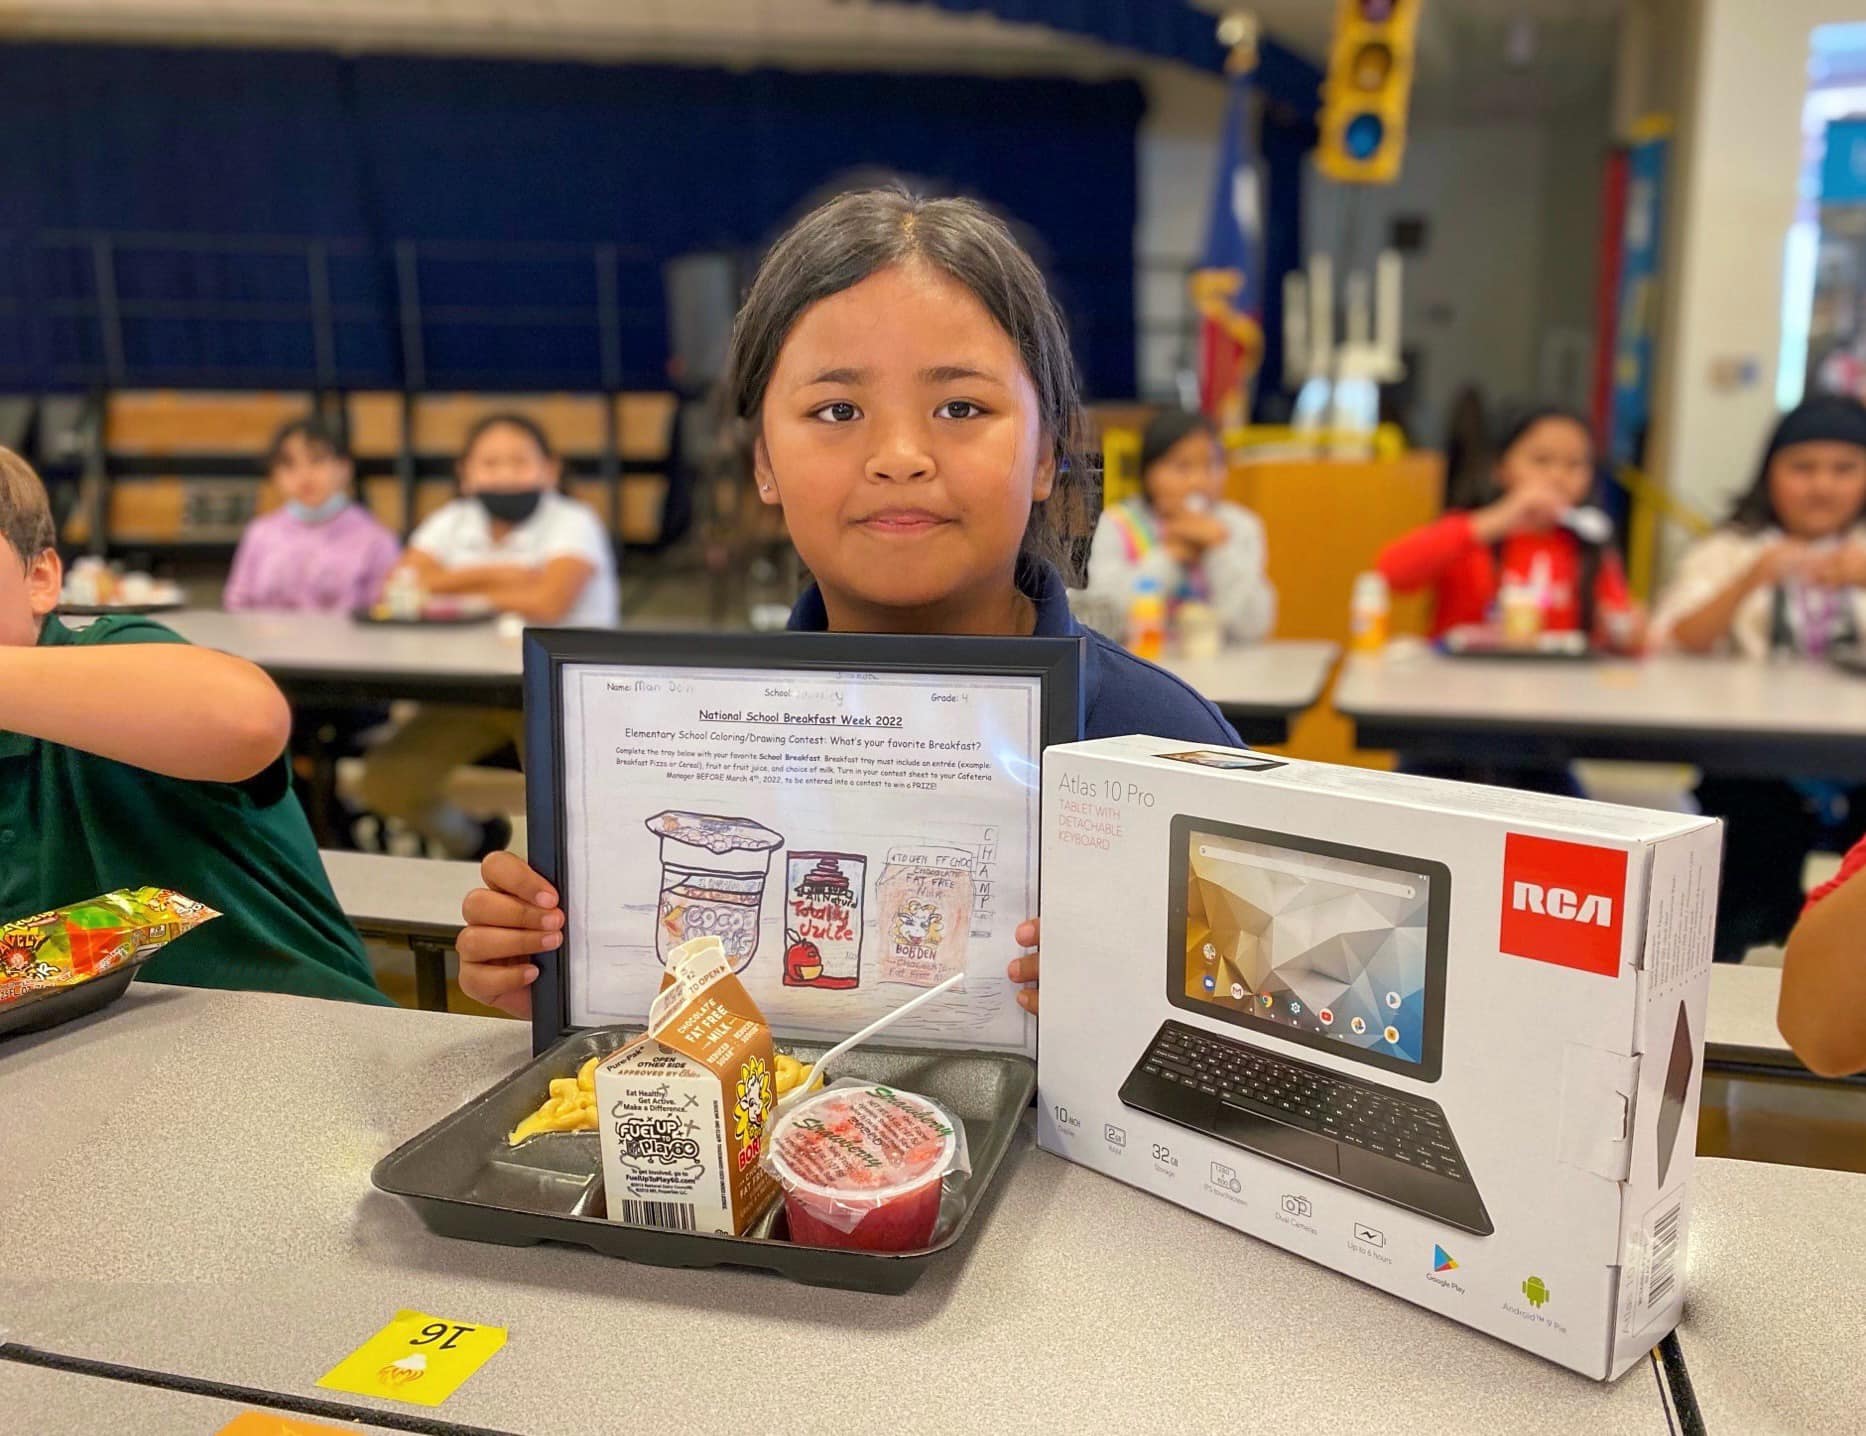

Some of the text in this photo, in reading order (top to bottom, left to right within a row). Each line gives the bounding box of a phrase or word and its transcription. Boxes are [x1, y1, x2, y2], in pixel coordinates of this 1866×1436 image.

[931, 692, 959, 704] Grade:
[961, 693, 968, 703] 4
[699, 710, 903, 728] National School Breakfast Week 2022
[625, 728, 982, 752] Elementary School Coloring/Drawing Contest: What's your favorite Breakfast?
[616, 746, 646, 757] Complete
[647, 748, 659, 756] the
[661, 749, 675, 758] tray
[677, 749, 695, 757] below
[697, 750, 712, 758] with
[714, 752, 729, 760] your
[730, 751, 757, 760] favorite
[759, 753, 782, 761] School
[824, 754, 859, 764] Breakfast
[861, 756, 875, 766] tray
[896, 759, 921, 767] include
[932, 760, 957, 768] entrée
[616, 758, 649, 767] Breakfast
[650, 759, 668, 768] Pizza
[706, 761, 722, 770] fruit
[733, 762, 749, 772] fruit
[771, 764, 784, 772] and
[785, 765, 808, 773] choice
[837, 766, 854, 775] Turn
[863, 769, 879, 777] your
[880, 769, 907, 777] contest
[908, 770, 929, 778] sheet
[957, 772, 992, 782] Cafeteria
[666, 772, 695, 782] Manager
[695, 773, 724, 782] BEFORE
[725, 774, 748, 783] March
[794, 777, 803, 785] be
[805, 777, 833, 786] entered
[834, 778, 848, 786] into
[856, 779, 882, 787] contest
[1059, 772, 1155, 808] Atlas 10 Pro
[1059, 799, 1121, 818] TABLET WITH
[1058, 816, 1123, 838] DETACHABLE
[1058, 830, 1111, 851] KEYBOARD
[1513, 880, 1613, 928] RCA
[698, 967, 721, 987] OPEN
[677, 997, 717, 1035] CHOCOLATE
[684, 1025, 706, 1044] FAT
[701, 1004, 729, 1029] FREE
[706, 1021, 734, 1043] MILK
[637, 1061, 666, 1069] OTHER
[652, 1056, 677, 1064] OPEN
[617, 1069, 664, 1077] APPROVED
[626, 1089, 637, 1097] Eat
[638, 1097, 651, 1105] Get
[623, 1103, 642, 1111] Make
[865, 1086, 955, 1139] Strawberry
[1054, 1105, 1069, 1123] 10
[619, 1120, 679, 1139] FUEL UP
[738, 1134, 762, 1172] BOR
[792, 1117, 882, 1168] Strawberry
[1152, 1143, 1170, 1164] 32
[1347, 1240, 1358, 1252] Up
[1358, 1246, 1367, 1255] to
[1373, 1252, 1393, 1265] hours
[1425, 1272, 1451, 1289] Google
[409, 1323, 475, 1350] 16
